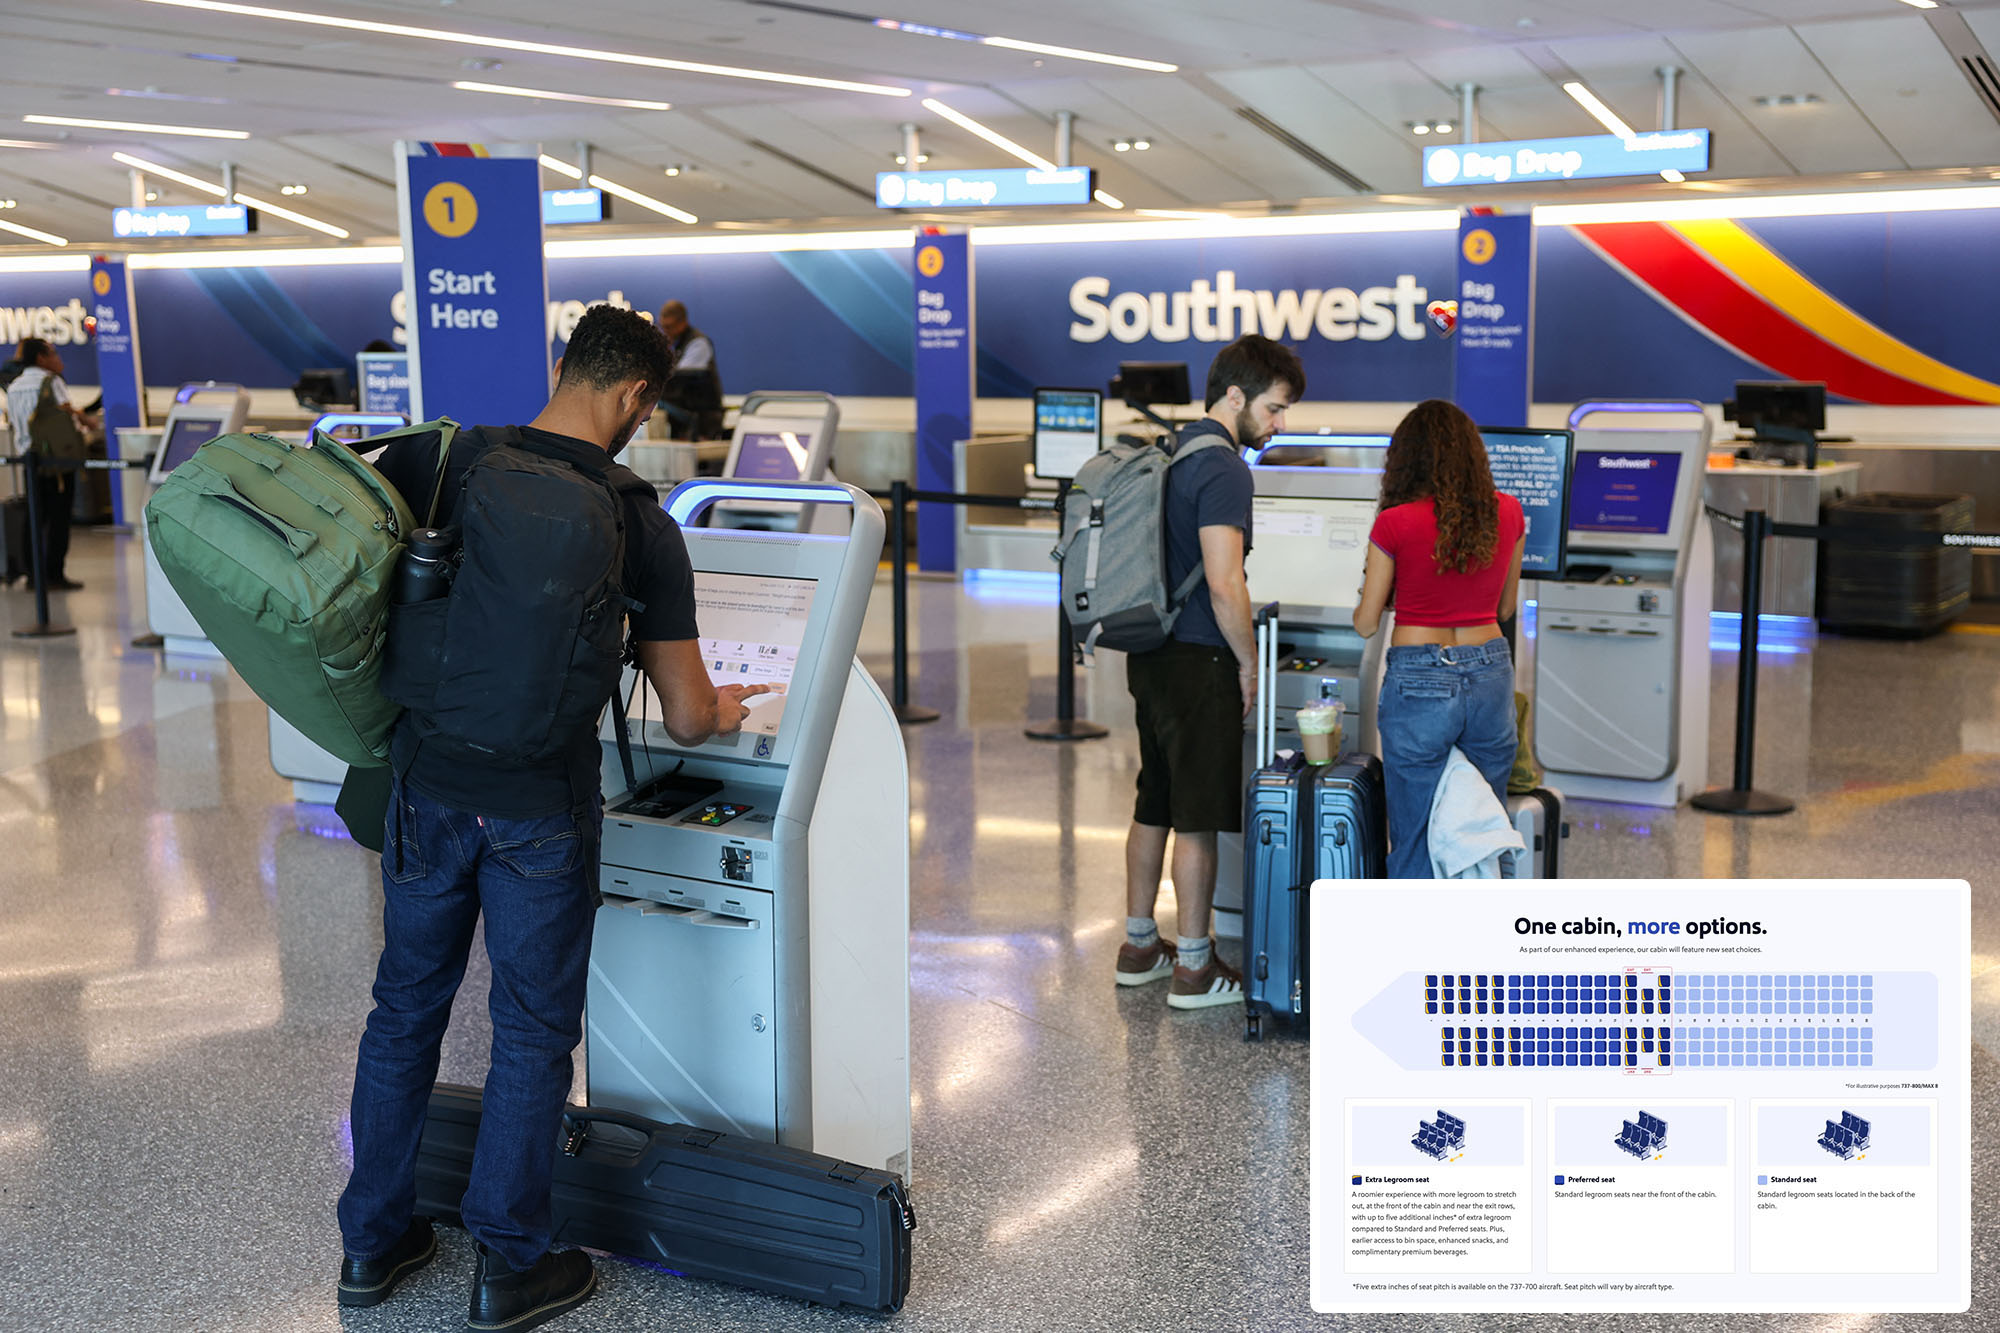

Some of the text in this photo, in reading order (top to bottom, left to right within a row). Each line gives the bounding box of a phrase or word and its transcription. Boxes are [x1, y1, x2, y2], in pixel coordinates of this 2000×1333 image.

[1463, 149, 1582, 182] Bag Drop
[441, 196, 455, 223] 1
[428, 268, 496, 295] Start
[1462, 280, 1495, 303] Bag
[431, 303, 498, 329] Here
[1069, 270, 1428, 343] Southwest
[1462, 300, 1505, 323] Drop
[1599, 456, 1650, 469] Southwest
